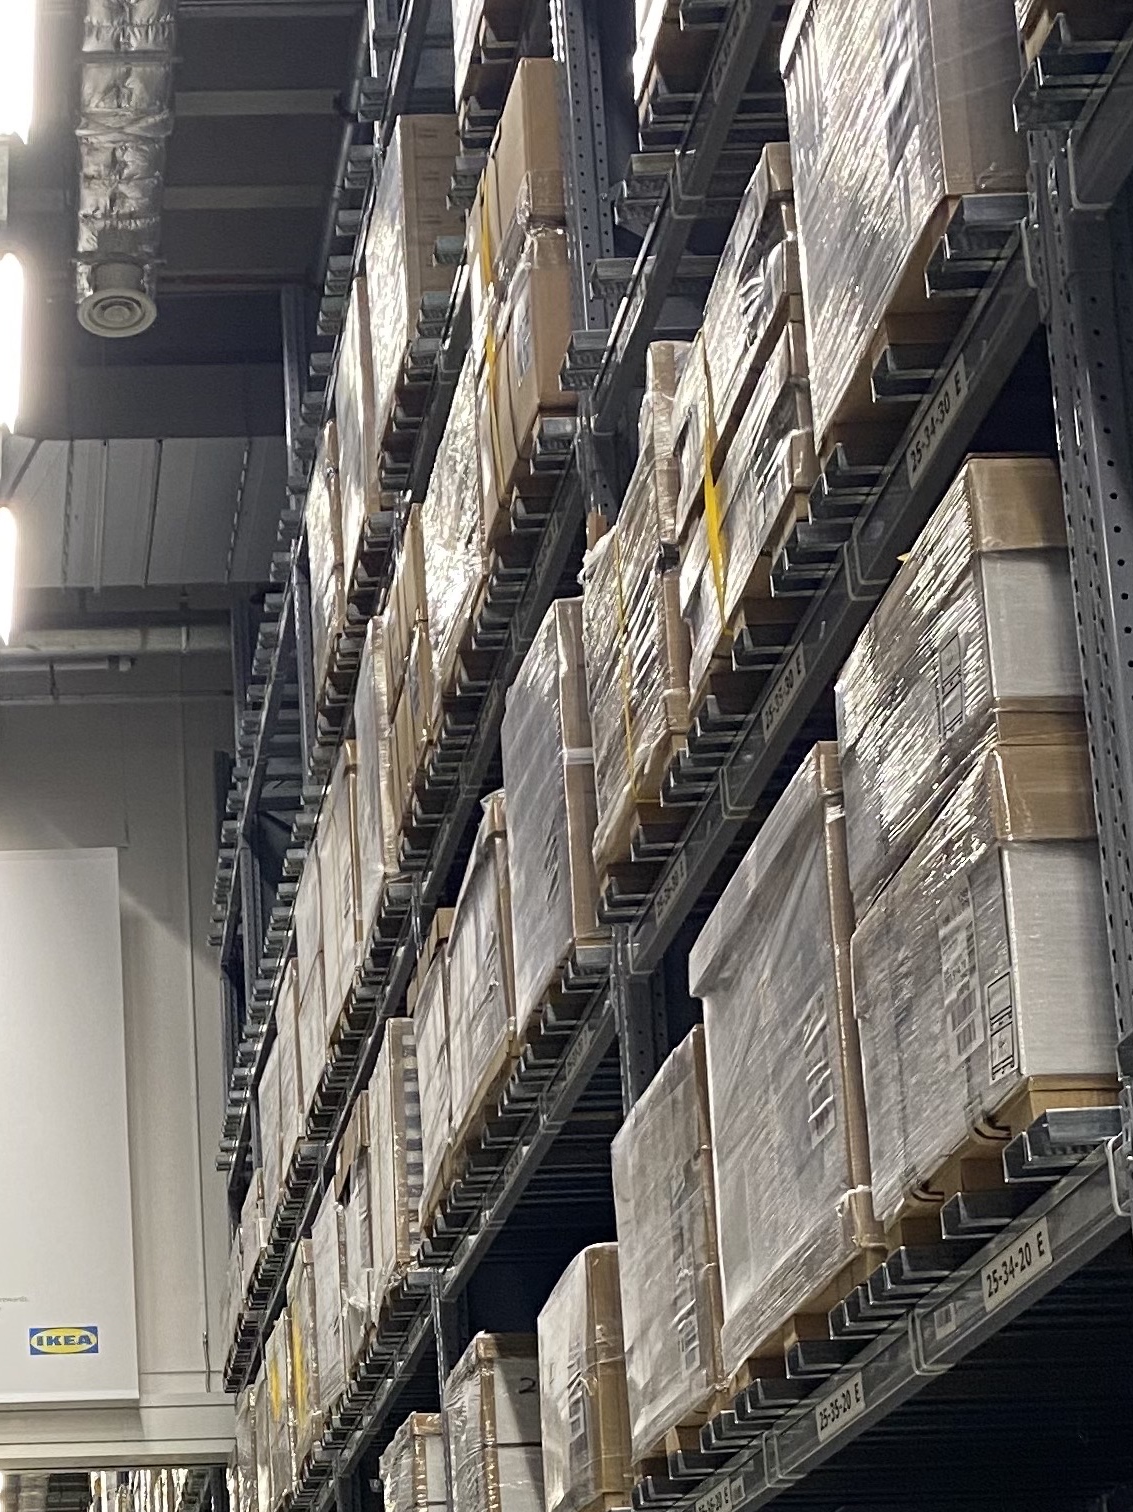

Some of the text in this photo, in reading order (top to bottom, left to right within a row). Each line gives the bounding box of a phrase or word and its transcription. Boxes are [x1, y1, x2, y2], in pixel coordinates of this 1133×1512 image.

[986, 1231, 1045, 1298] 25-34-20 E
[36, 1335, 93, 1346] IKEA
[518, 1376, 538, 1394] 2
[854, 1382, 861, 1404] E
